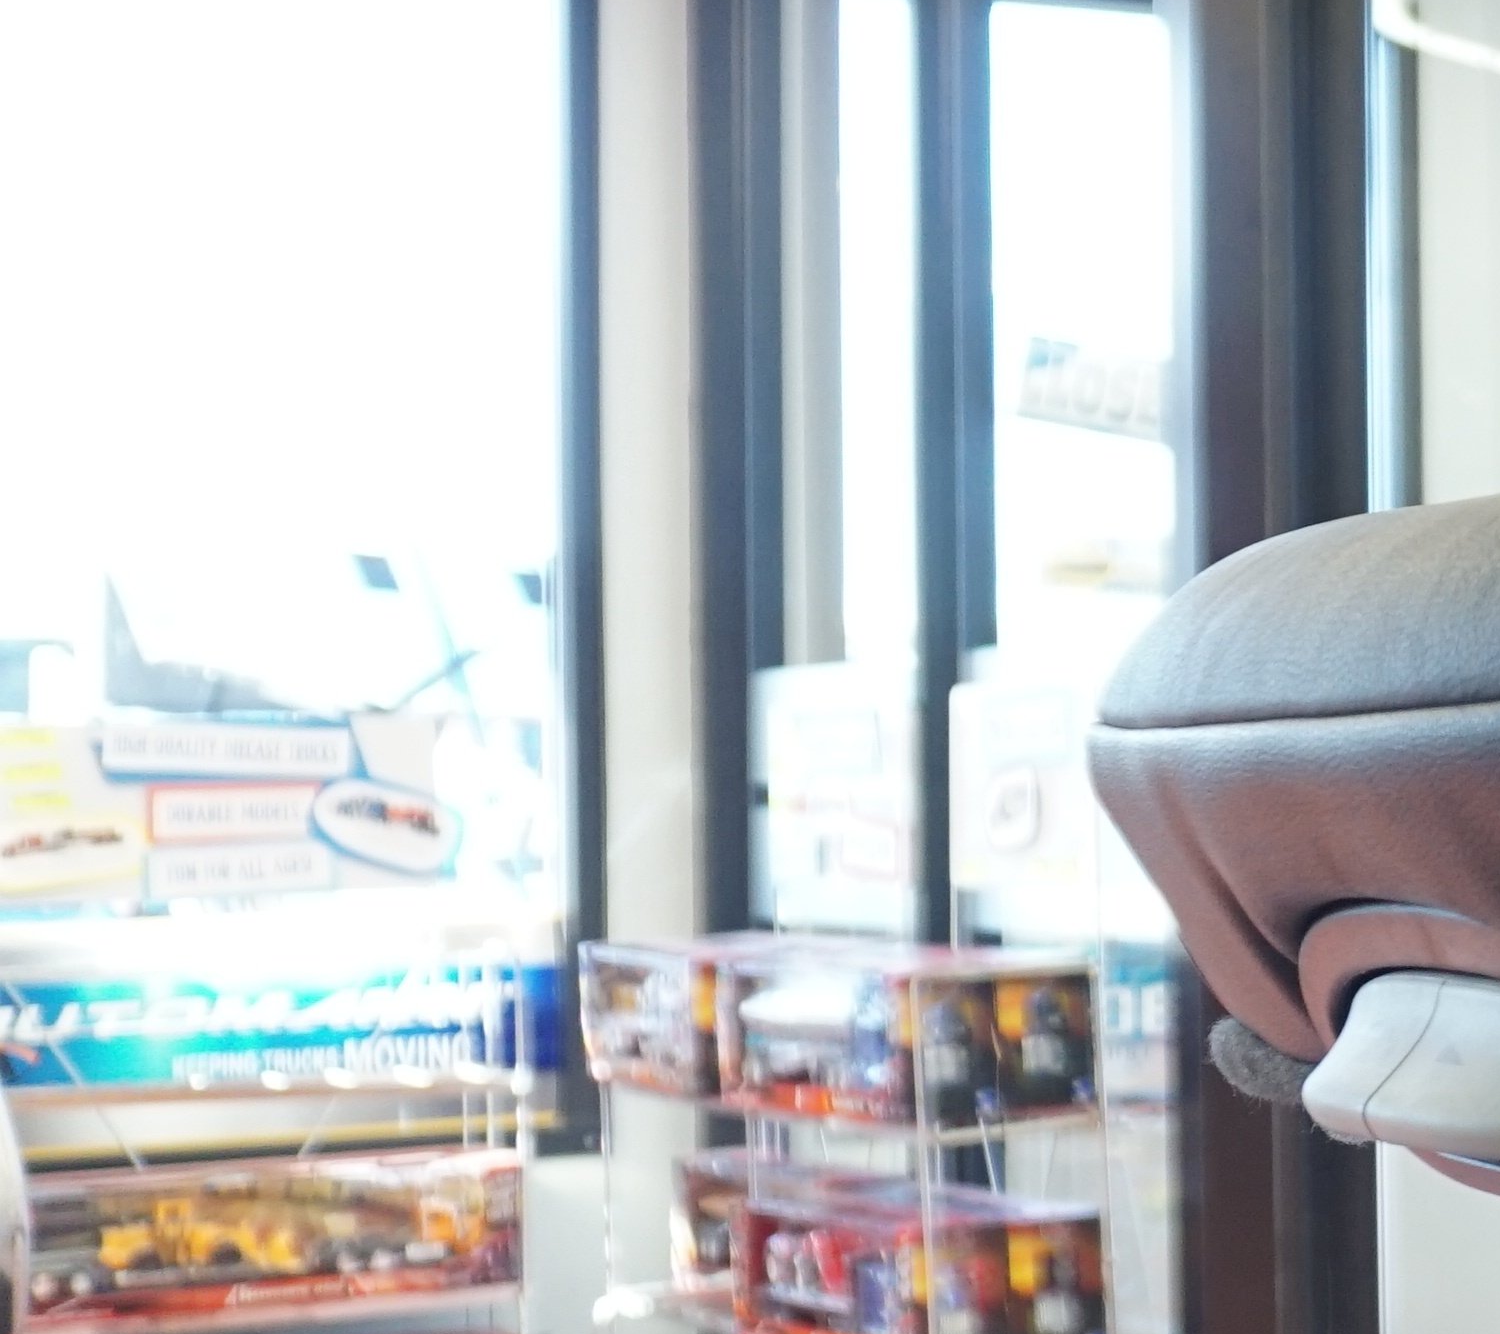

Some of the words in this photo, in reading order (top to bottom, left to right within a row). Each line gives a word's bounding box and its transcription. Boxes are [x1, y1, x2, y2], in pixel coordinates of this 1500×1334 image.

[156, 737, 217, 757] QUALITY
[289, 741, 338, 762] TRUCKS
[167, 803, 231, 826] DURABLE
[240, 800, 300, 822] MODELS
[238, 858, 264, 878] ALL
[344, 1033, 472, 1072] MOVING
